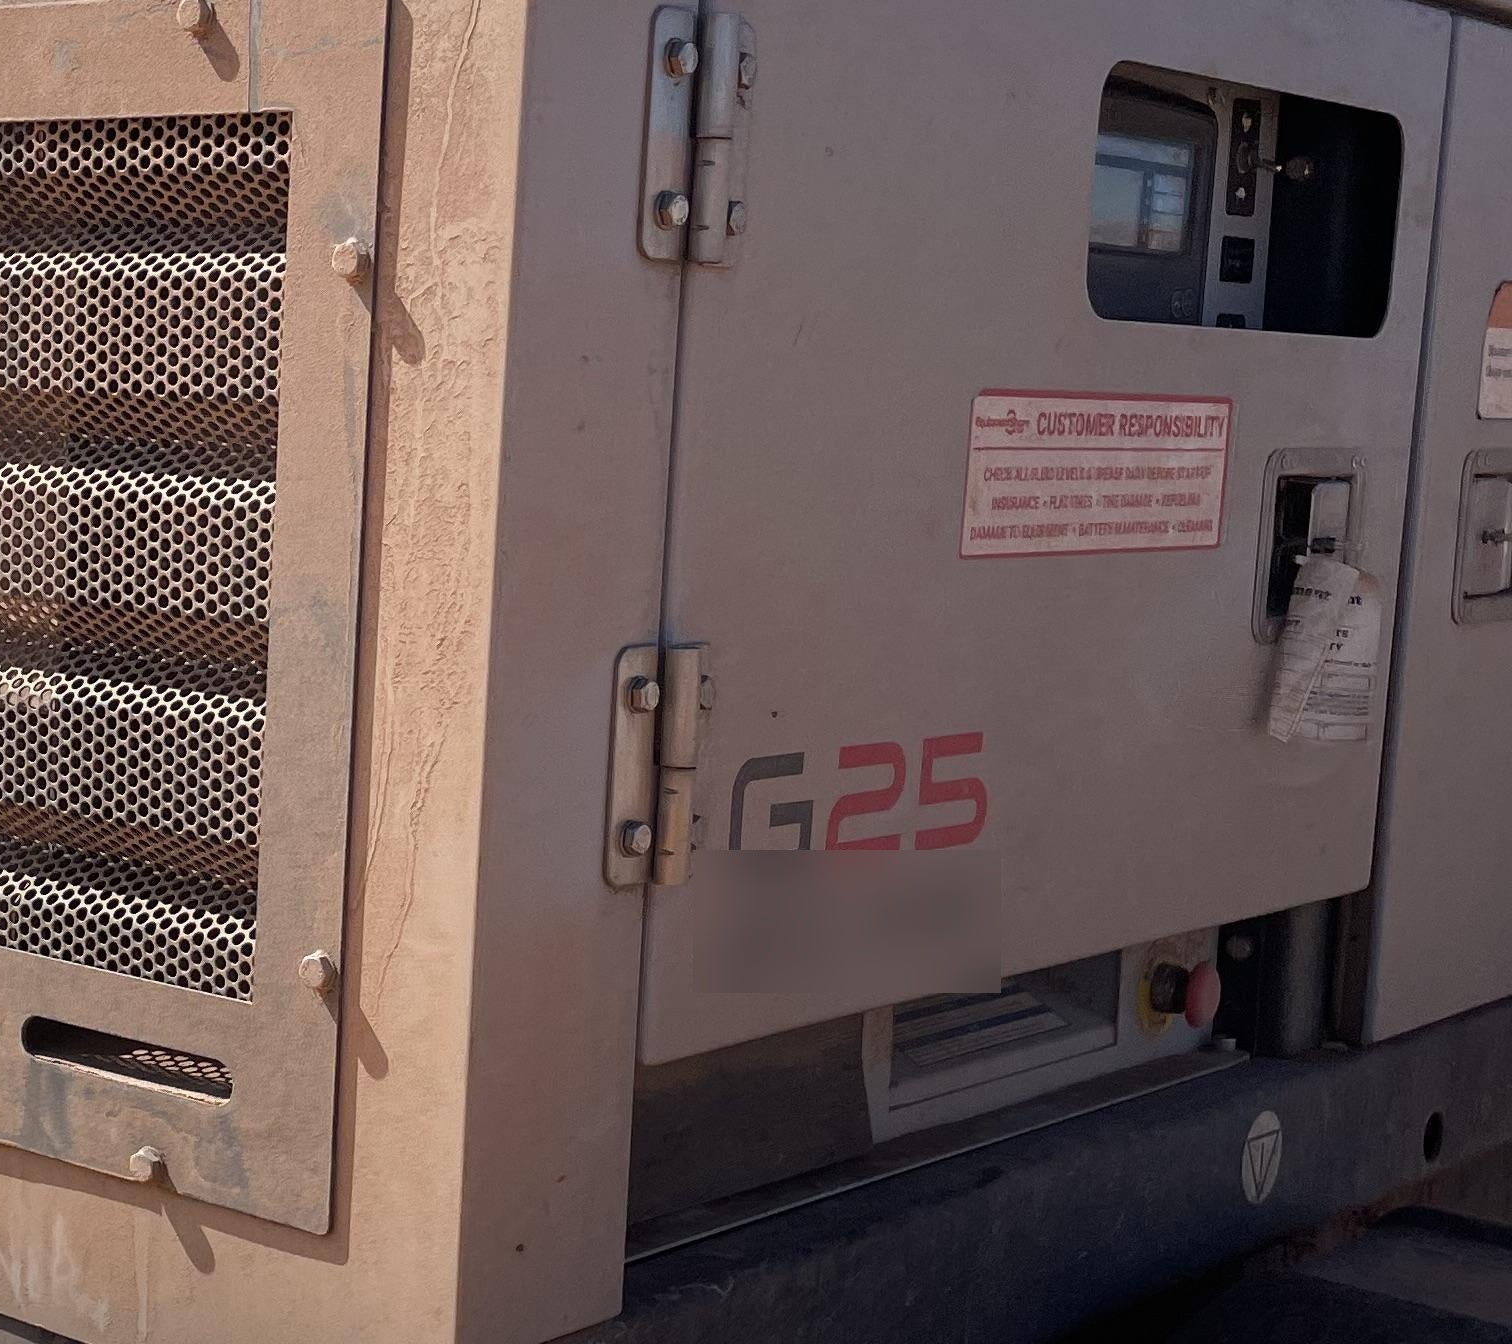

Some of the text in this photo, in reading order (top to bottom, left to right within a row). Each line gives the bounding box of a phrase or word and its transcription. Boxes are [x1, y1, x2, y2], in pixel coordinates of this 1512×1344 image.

[1036, 411, 1115, 437] CUSTOMER
[1119, 413, 1226, 438] RESPONSIBILITY
[728, 731, 988, 852] G25
